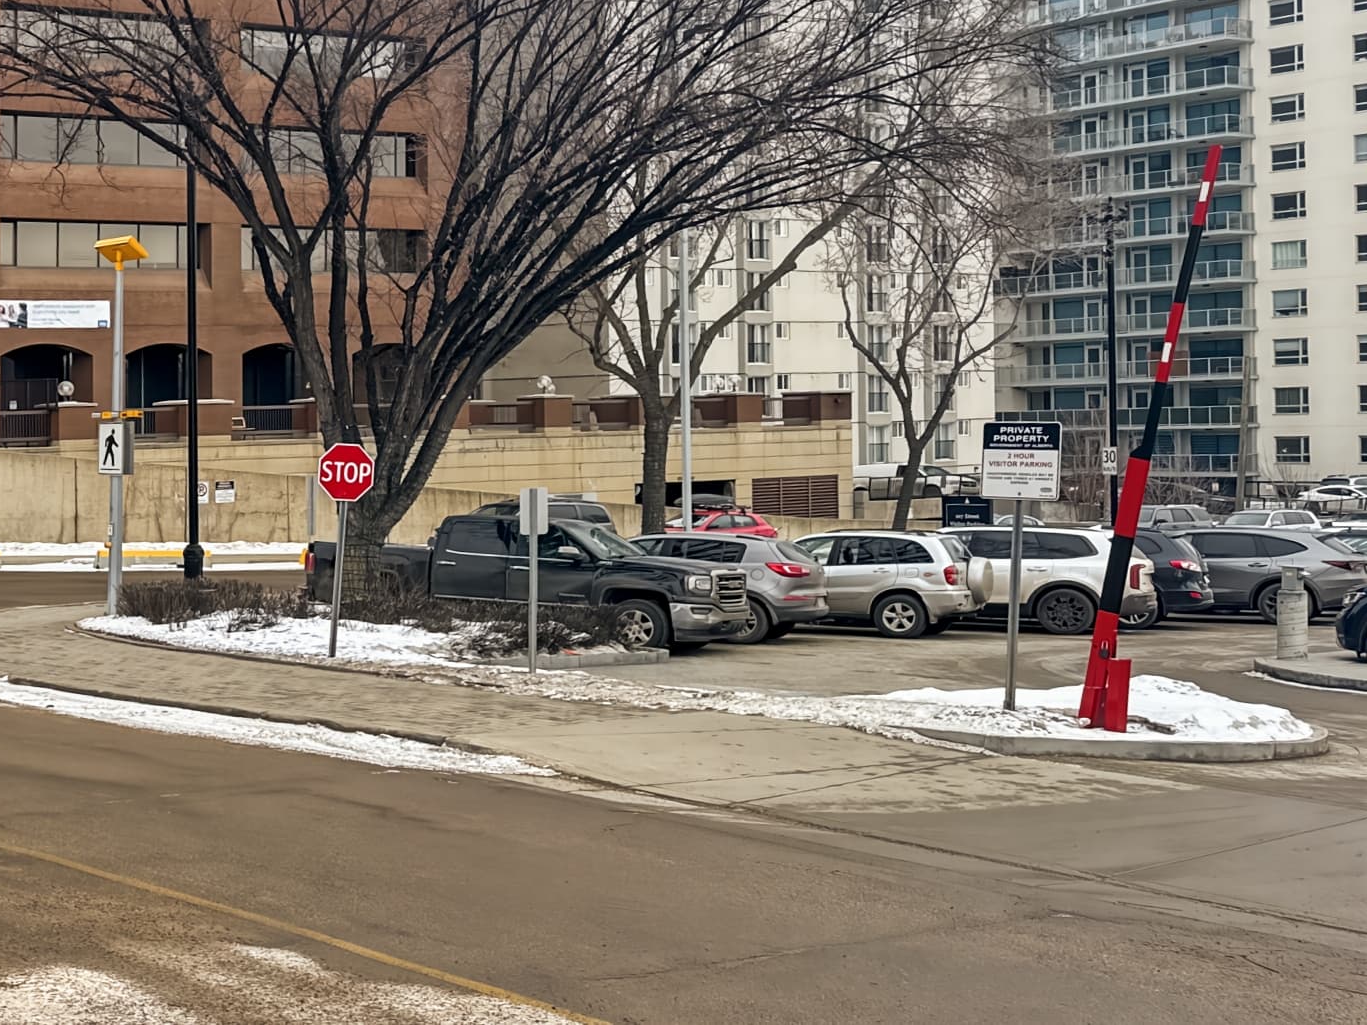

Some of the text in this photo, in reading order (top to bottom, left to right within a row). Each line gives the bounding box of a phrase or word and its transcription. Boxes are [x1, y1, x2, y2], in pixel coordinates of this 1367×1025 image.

[1000, 426, 1043, 434] PRIVATE
[993, 435, 1050, 443] PROPERTY
[1103, 450, 1116, 463] 30
[321, 460, 371, 484] STOP
